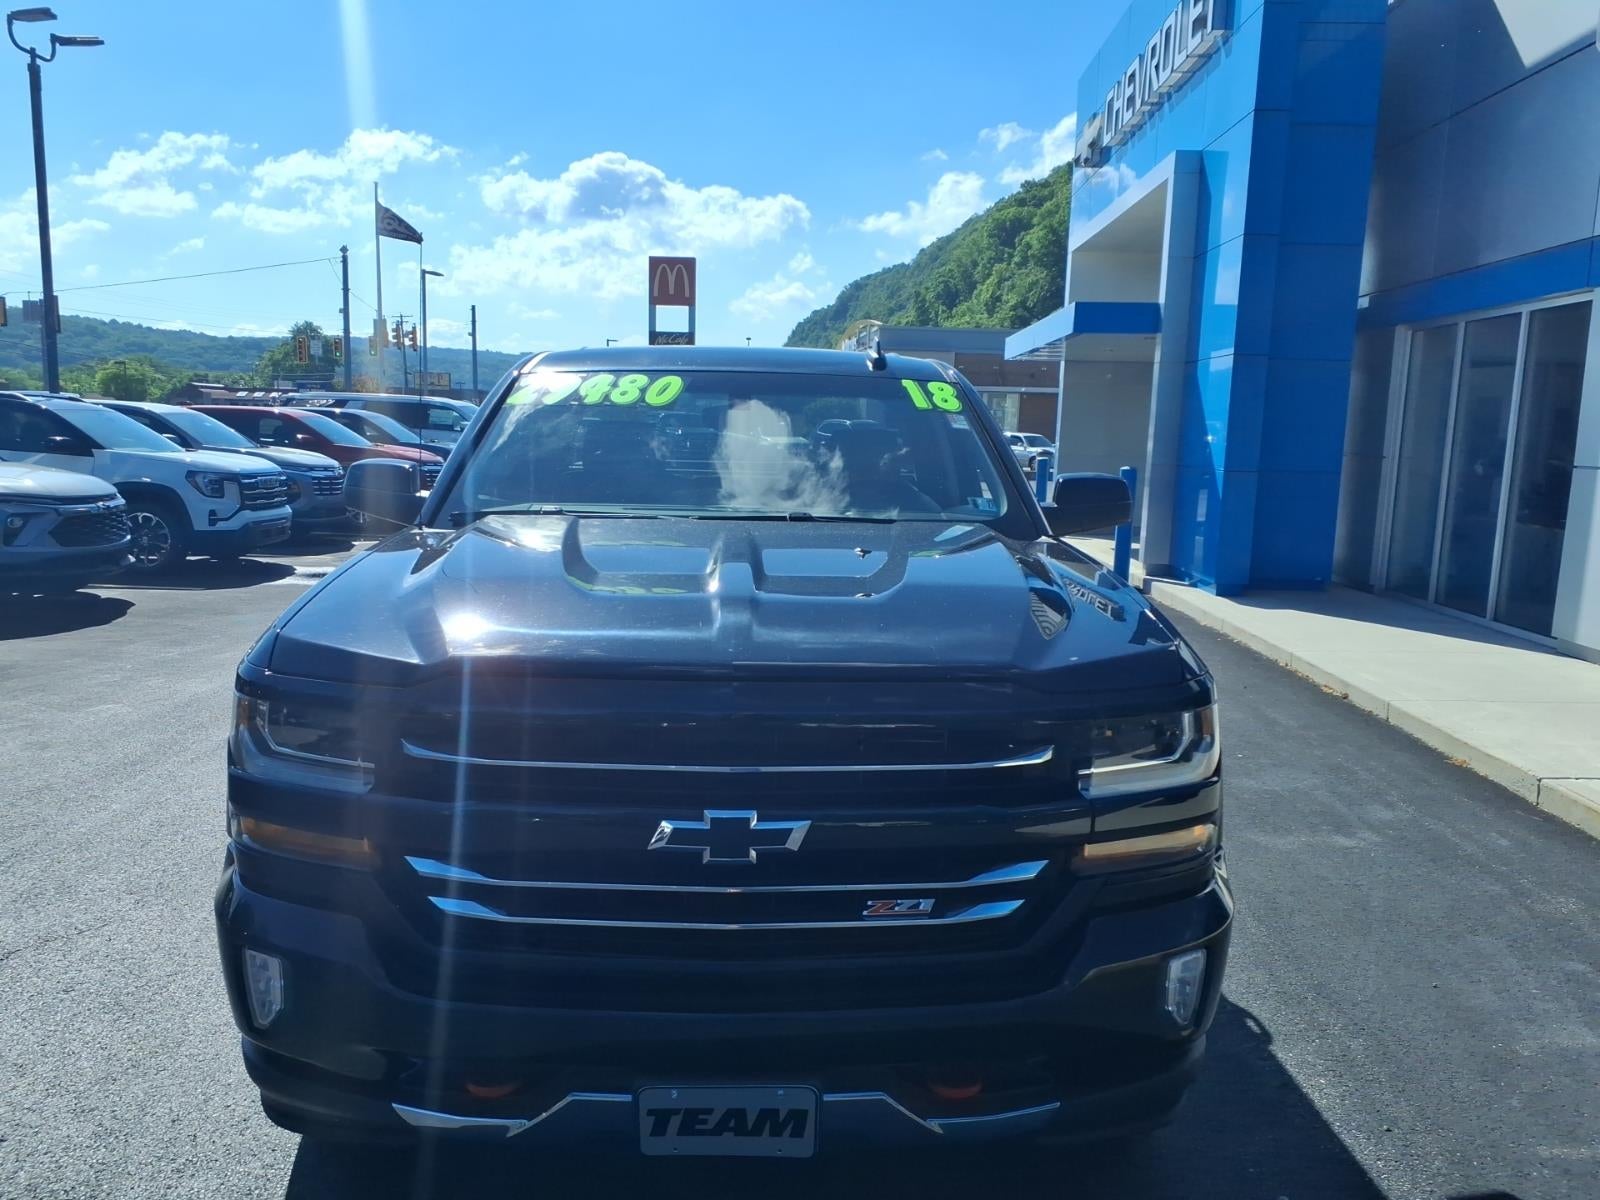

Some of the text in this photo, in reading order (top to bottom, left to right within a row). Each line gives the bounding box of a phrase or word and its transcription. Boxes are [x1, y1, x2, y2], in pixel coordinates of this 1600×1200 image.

[901, 379, 963, 412] 18
[863, 899, 936, 915] Z71
[646, 1108, 809, 1138] TEAM
